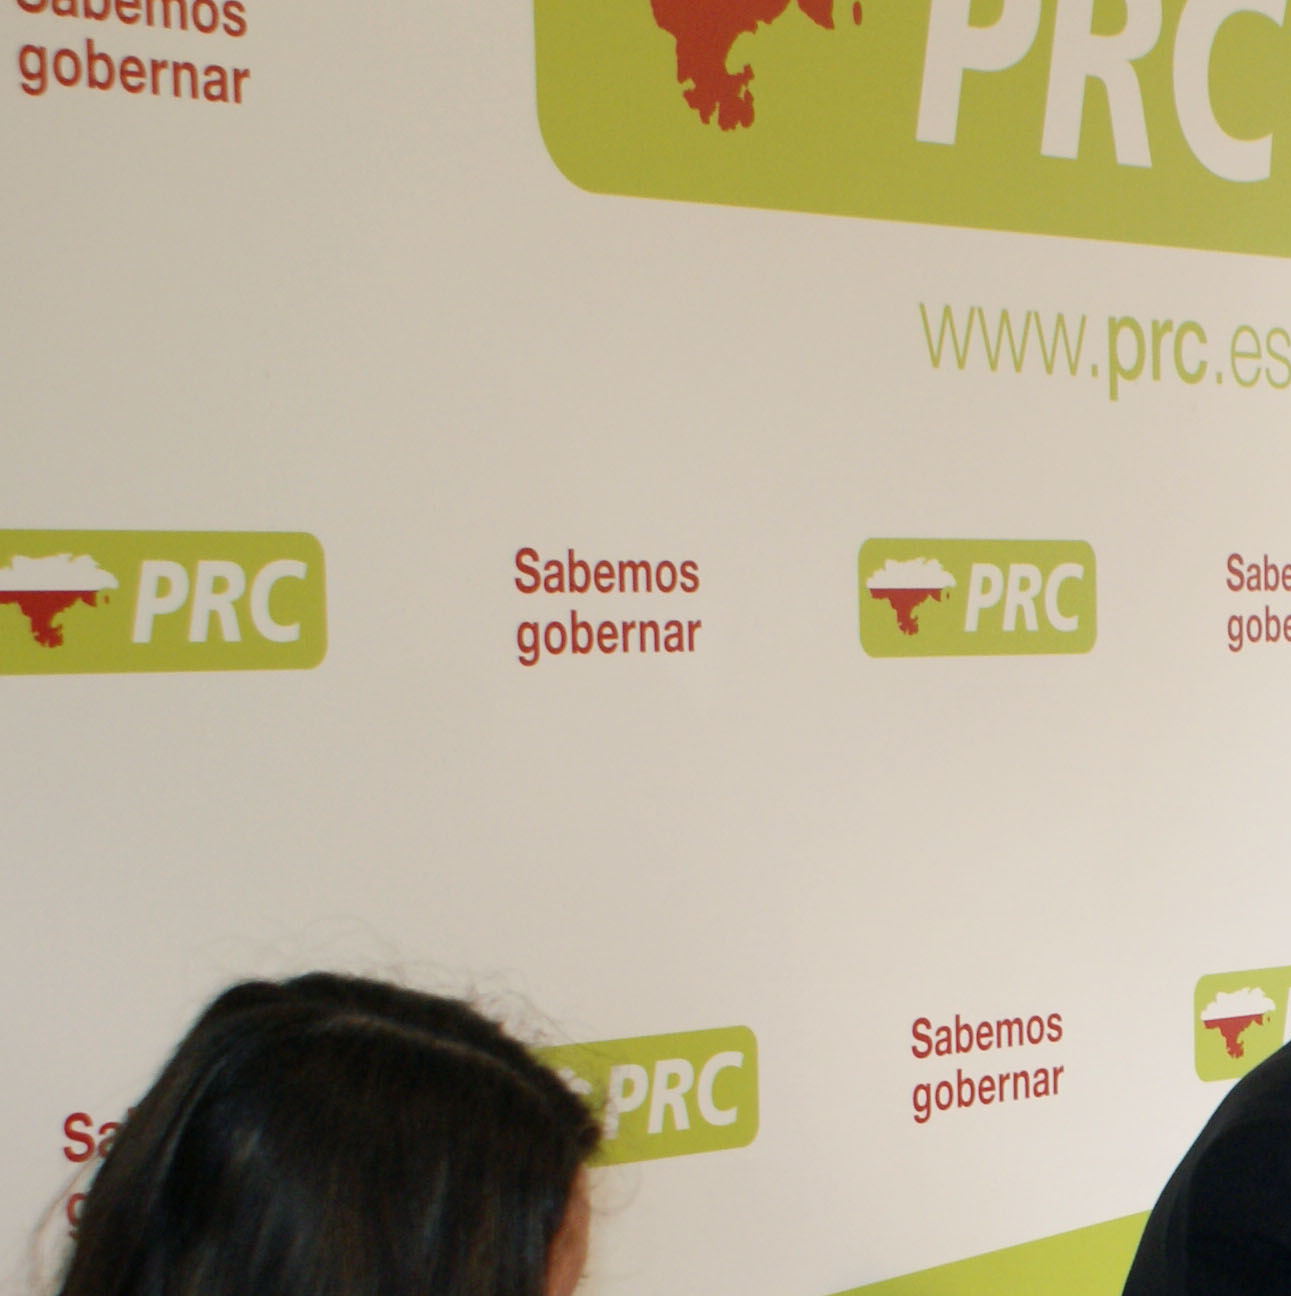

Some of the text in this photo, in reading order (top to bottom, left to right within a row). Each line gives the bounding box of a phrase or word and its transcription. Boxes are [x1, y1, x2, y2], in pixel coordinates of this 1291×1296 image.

[18, 38, 251, 105] gobernar
[915, 0, 1287, 183] PRC
[132, 560, 308, 644] PRC
[514, 547, 700, 595] Sabemos
[964, 562, 1085, 633] PRC
[516, 610, 702, 668] gobernar
[911, 1012, 1064, 1061] Sabemos
[603, 1050, 745, 1140] PRC
[911, 1065, 1065, 1124] gobernar
